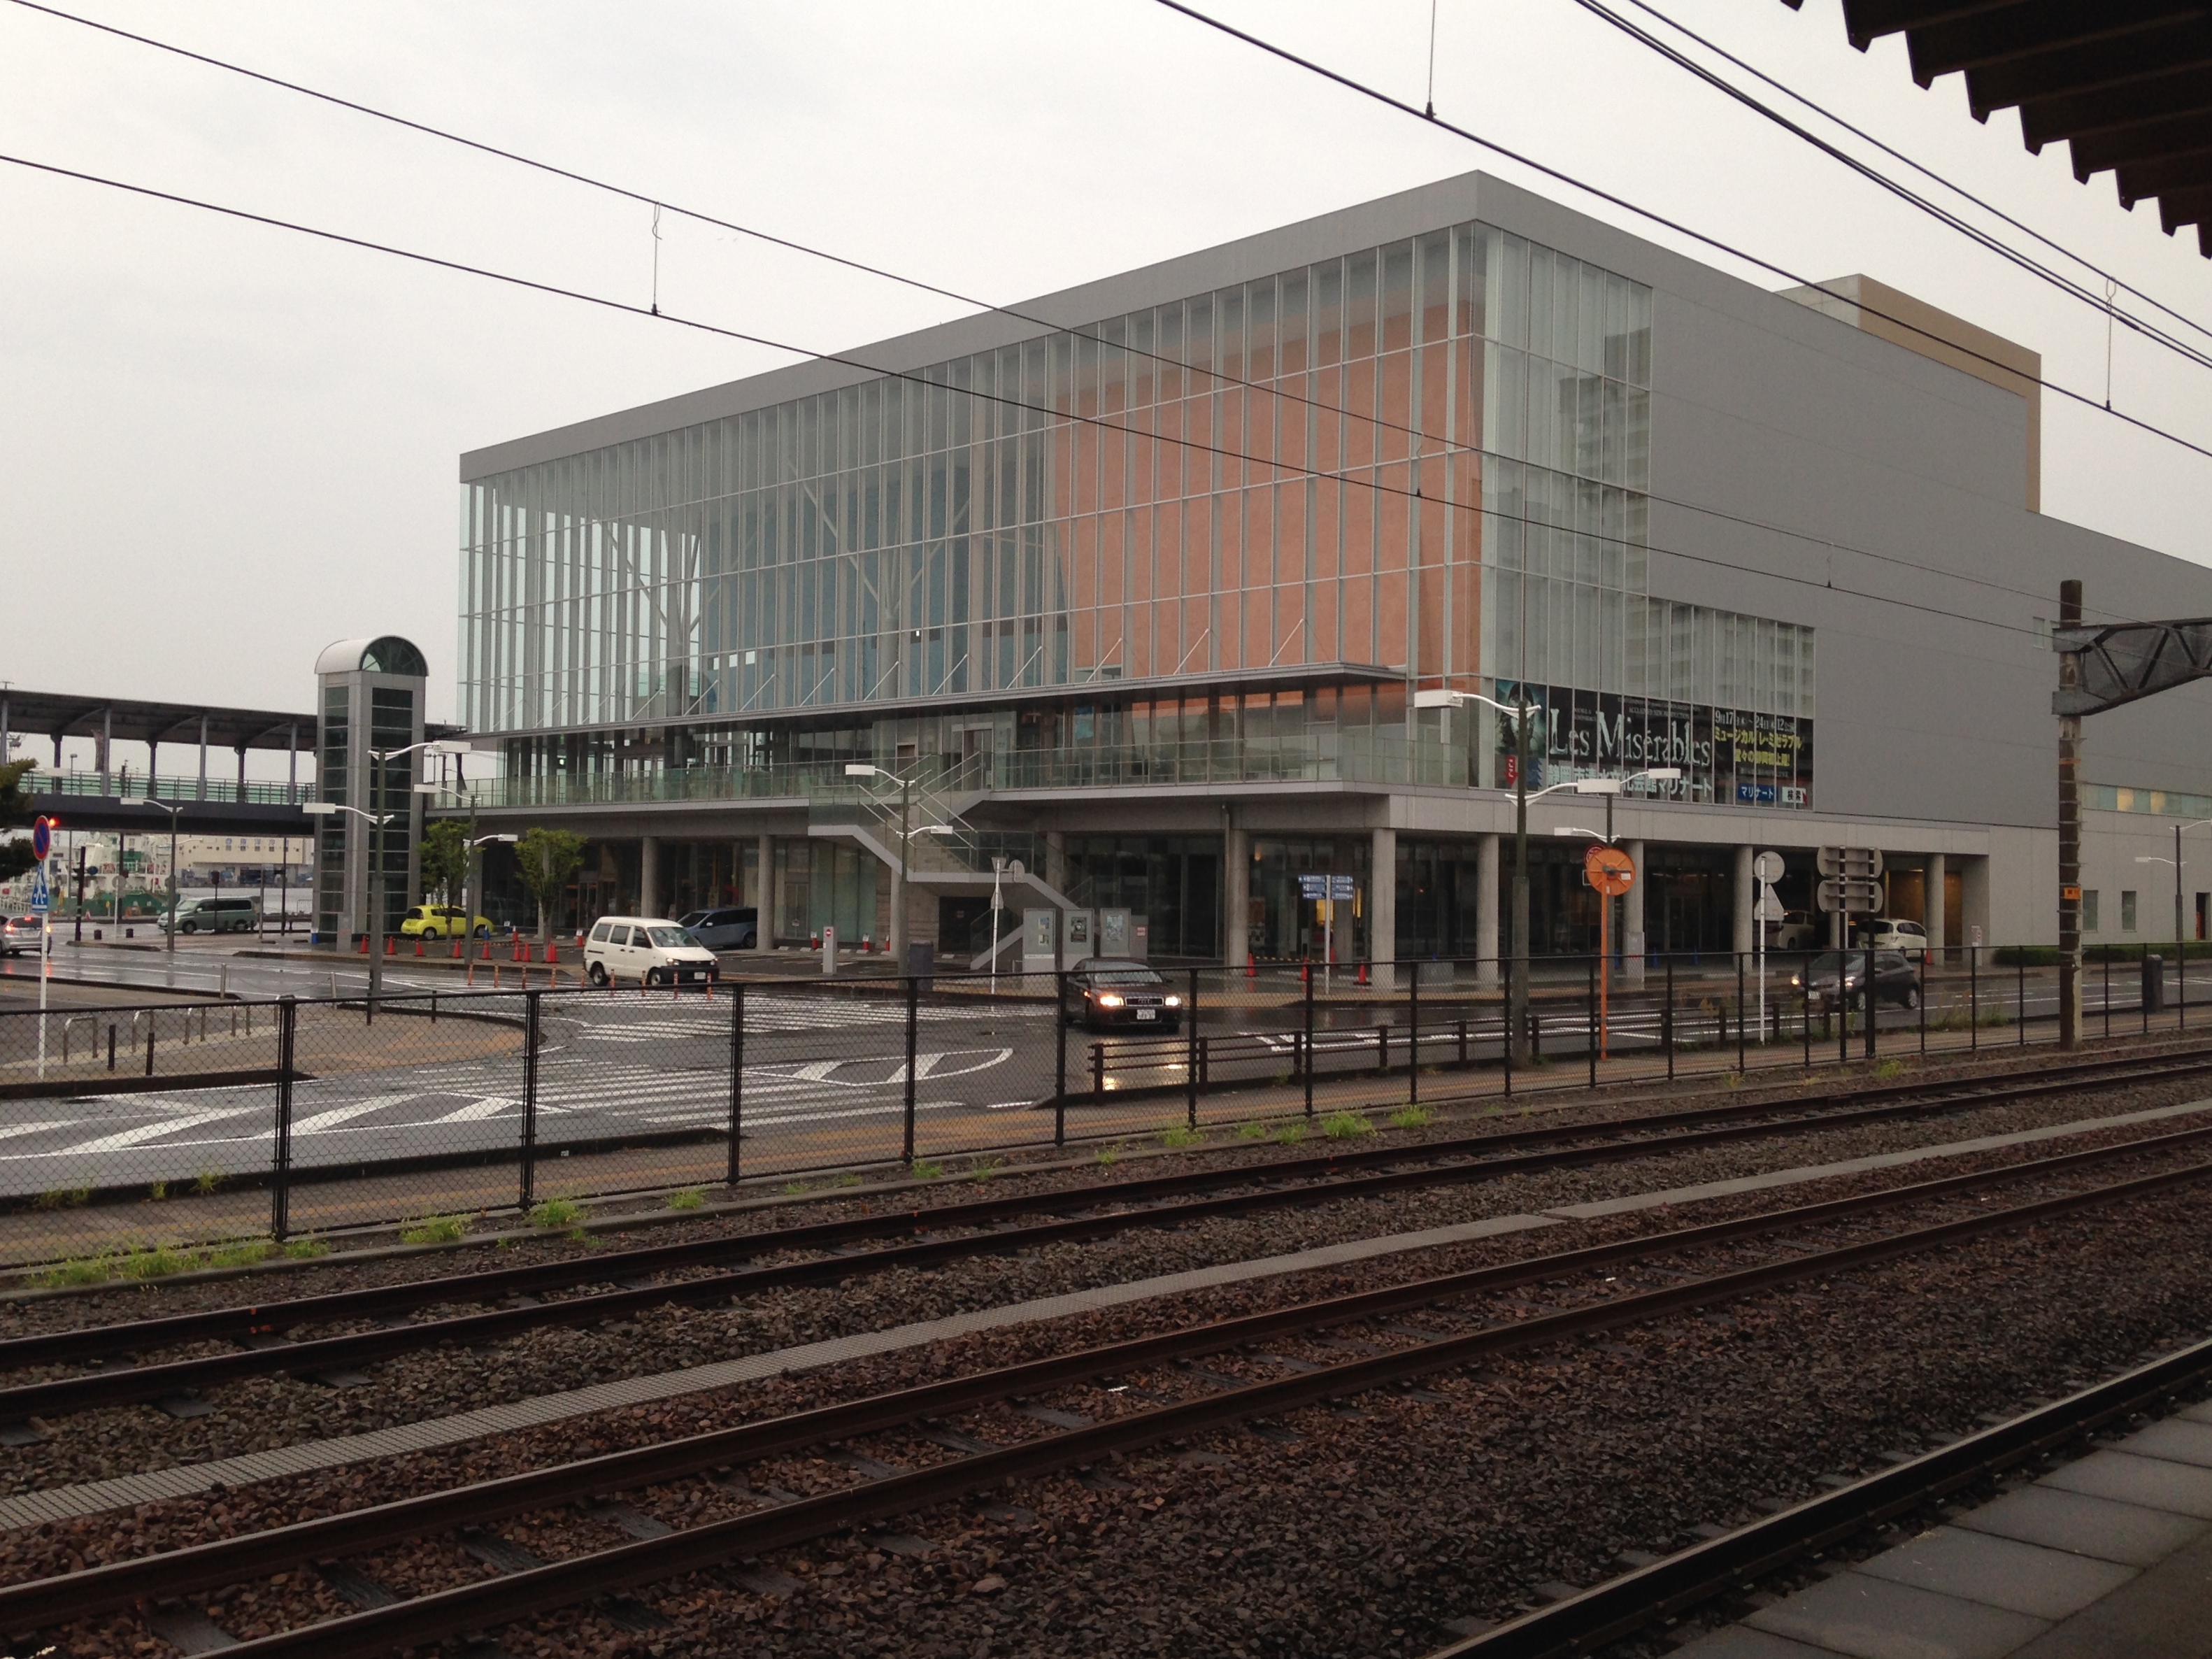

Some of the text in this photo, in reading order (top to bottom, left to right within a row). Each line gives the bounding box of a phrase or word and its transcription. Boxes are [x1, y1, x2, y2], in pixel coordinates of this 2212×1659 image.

[1550, 708, 1711, 767] Les Misérables
[1741, 786, 1774, 799] マリナート
